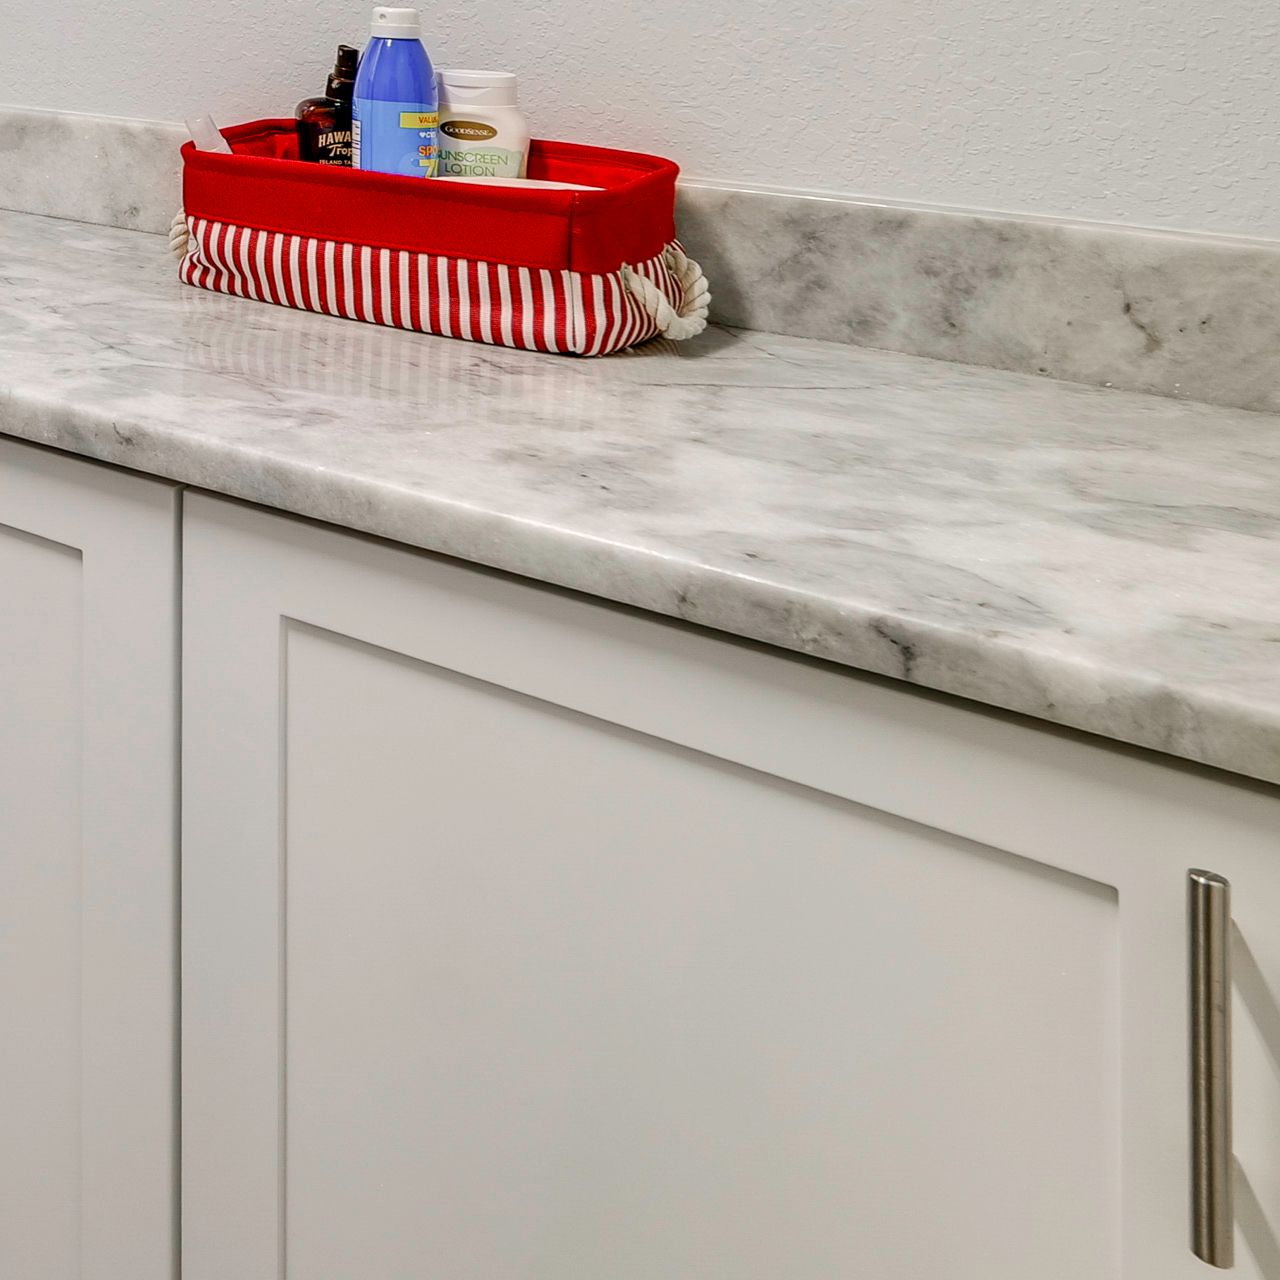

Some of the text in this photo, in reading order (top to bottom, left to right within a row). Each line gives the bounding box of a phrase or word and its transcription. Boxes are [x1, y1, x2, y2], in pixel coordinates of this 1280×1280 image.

[318, 131, 352, 148] HAWA
[327, 143, 352, 157] Trop
[438, 150, 509, 165] UNSCREEN
[444, 163, 496, 177] LOTION
